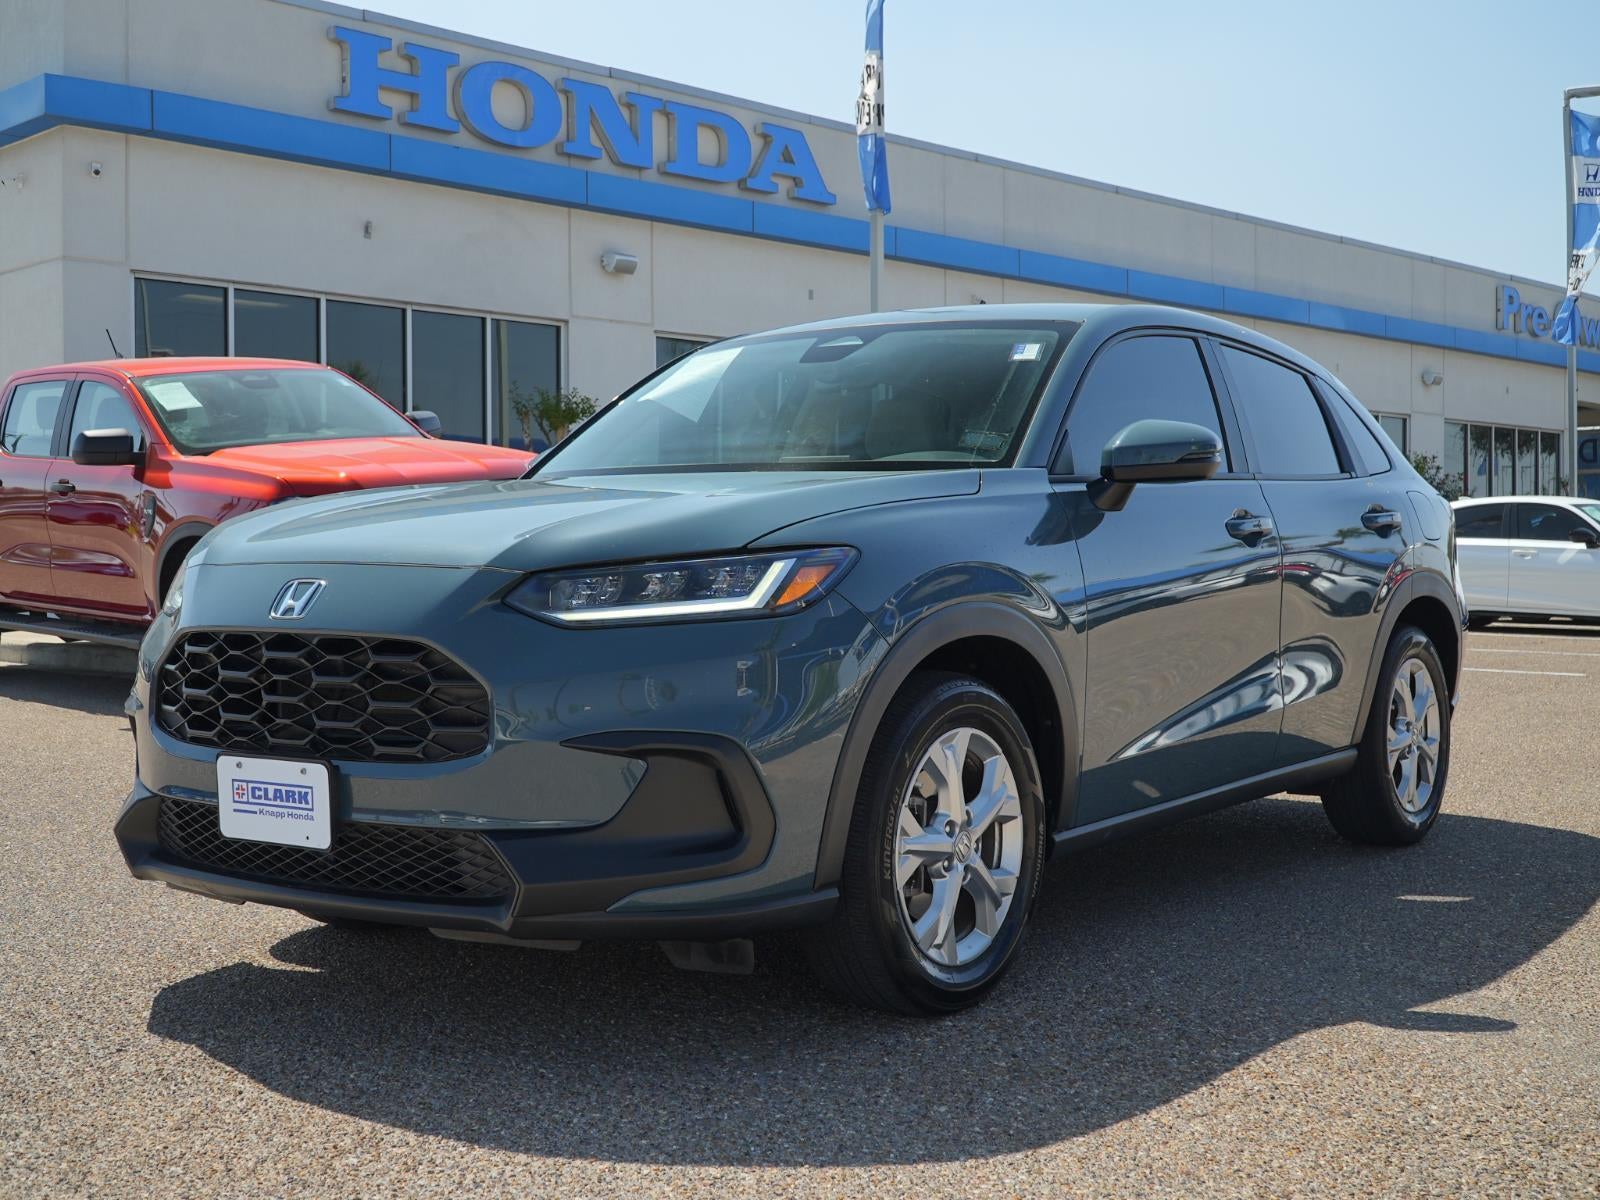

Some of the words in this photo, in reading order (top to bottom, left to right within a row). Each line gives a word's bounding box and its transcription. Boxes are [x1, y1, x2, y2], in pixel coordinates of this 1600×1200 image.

[329, 26, 837, 205] HONDA
[251, 786, 310, 805] CLARK
[258, 808, 286, 819] Knapp
[287, 811, 315, 821] Honda
